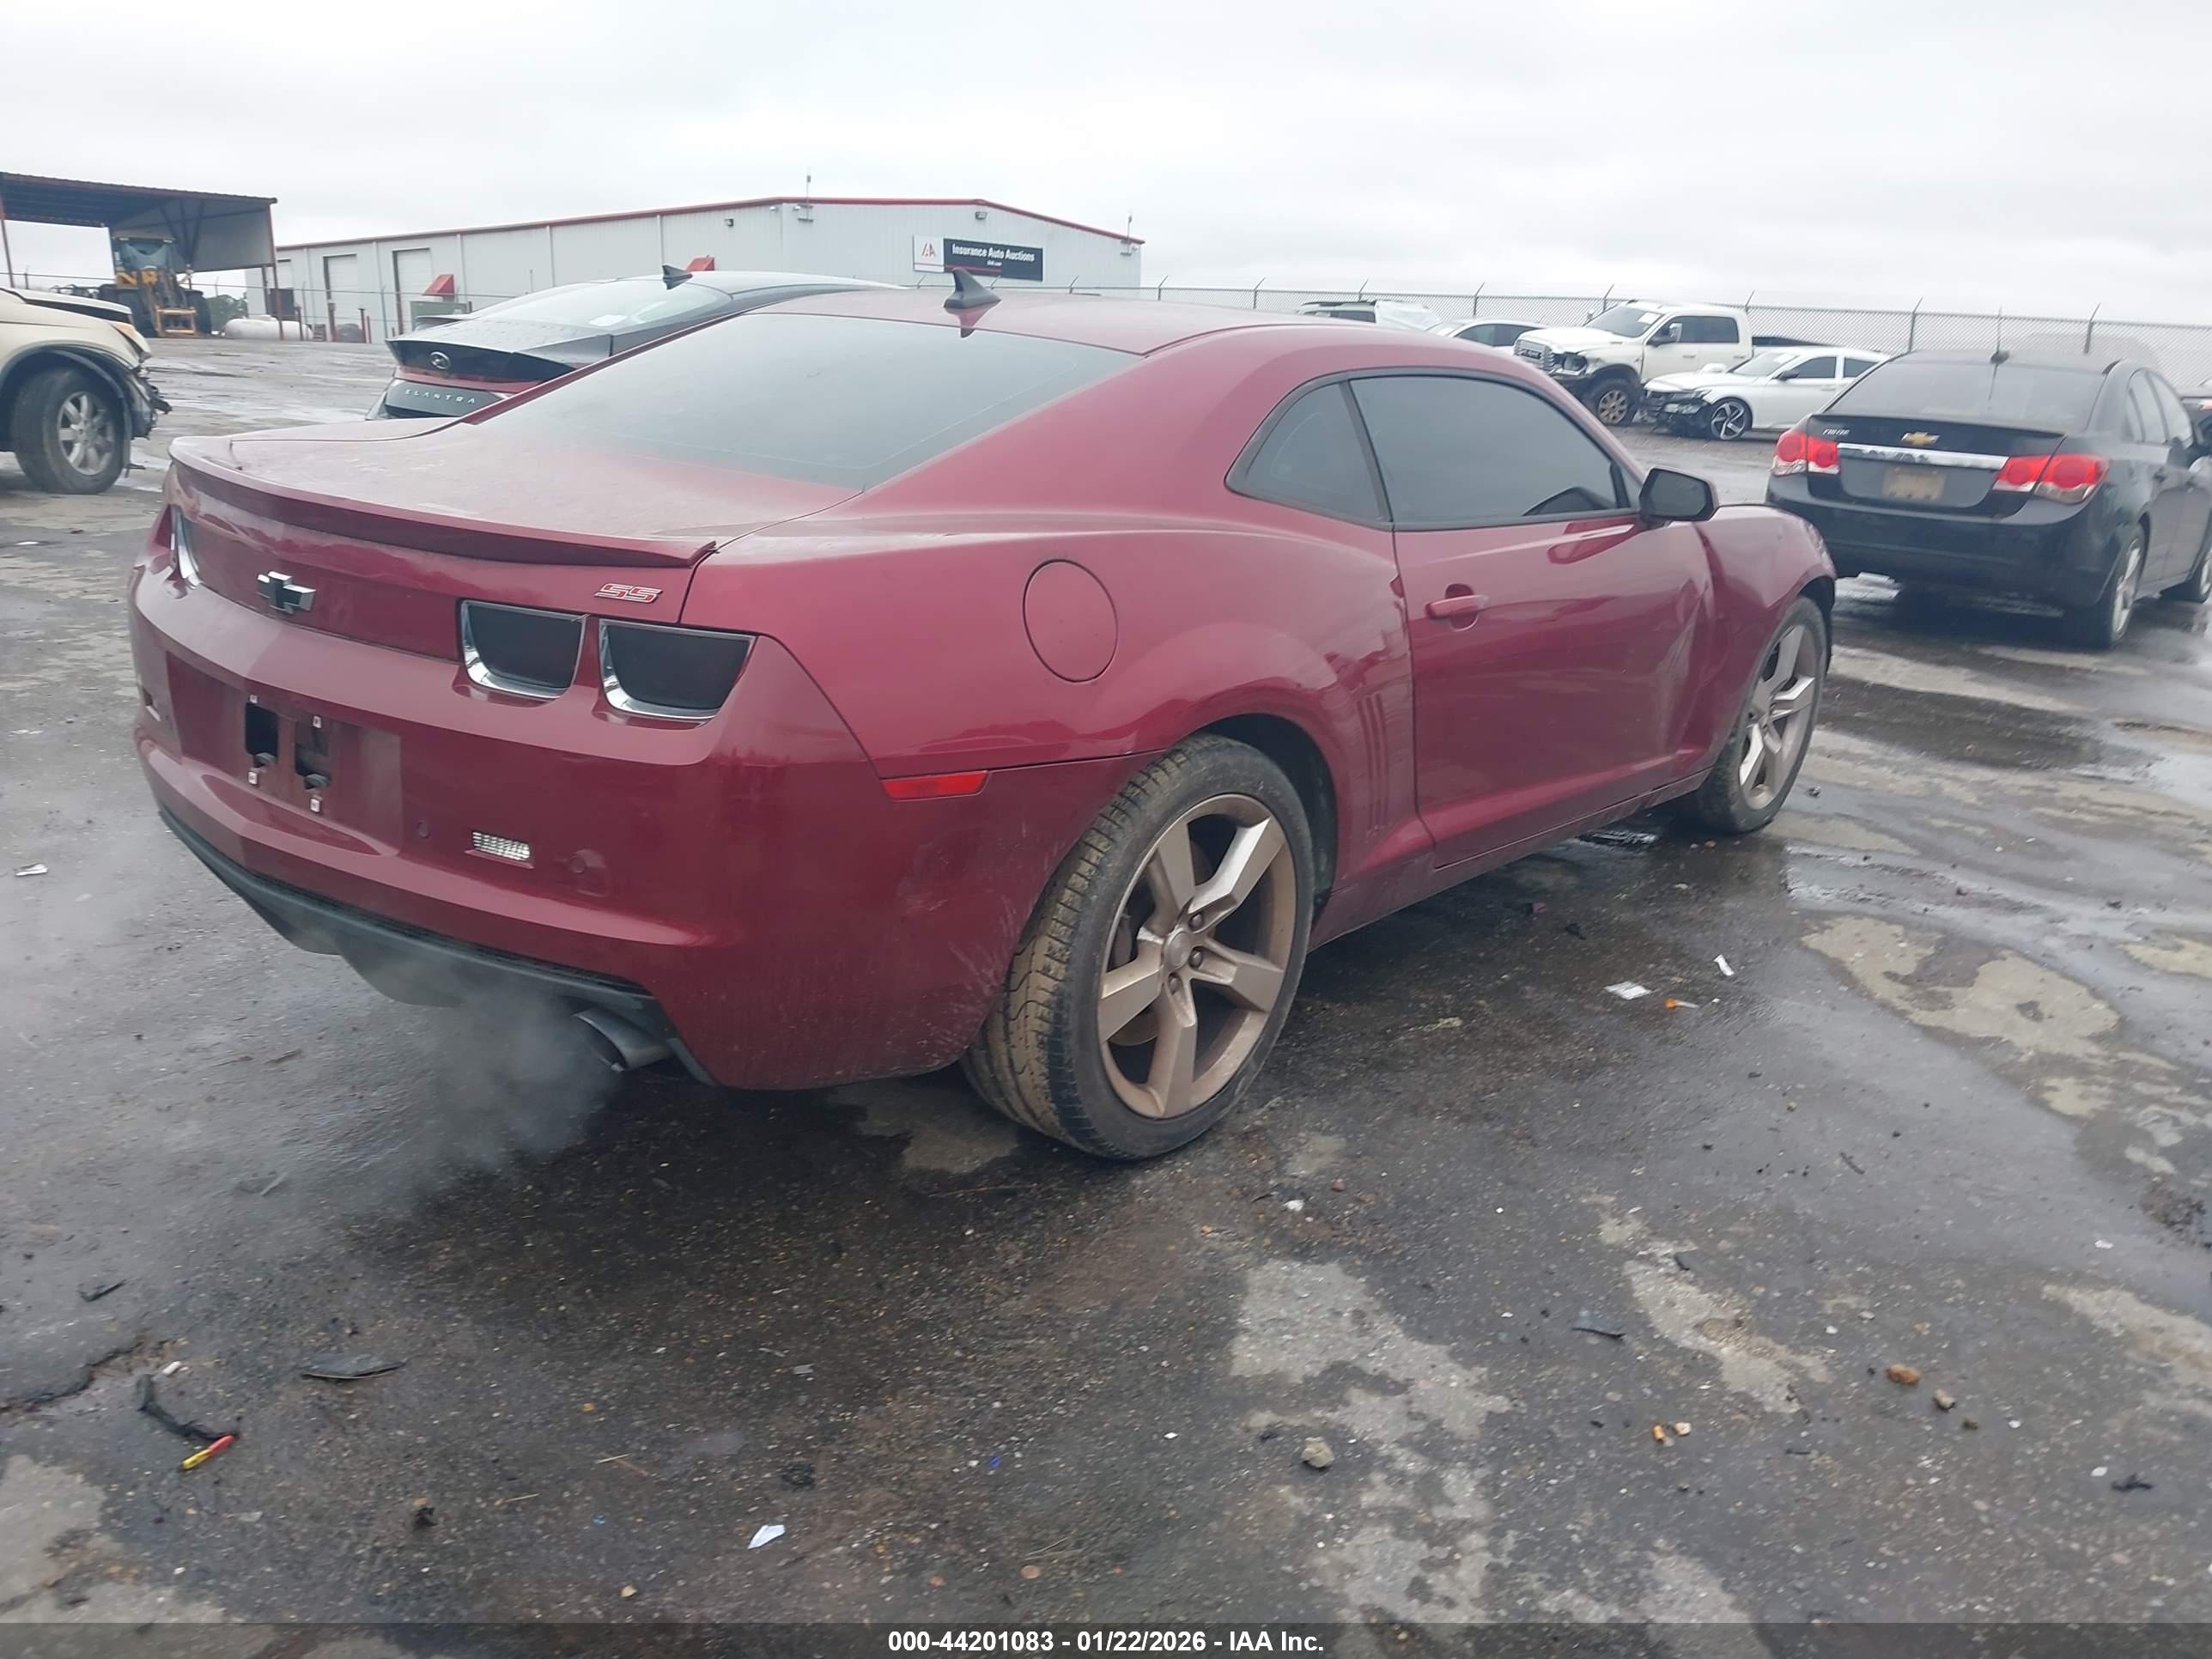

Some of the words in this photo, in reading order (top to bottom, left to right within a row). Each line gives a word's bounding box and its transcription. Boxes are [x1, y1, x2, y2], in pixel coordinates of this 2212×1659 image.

[951, 243, 988, 258] Insurance
[988, 246, 1005, 259] Auto
[1006, 248, 1036, 262] Auctions
[405, 389, 475, 404] ELANTRA
[593, 583, 664, 604] SS
